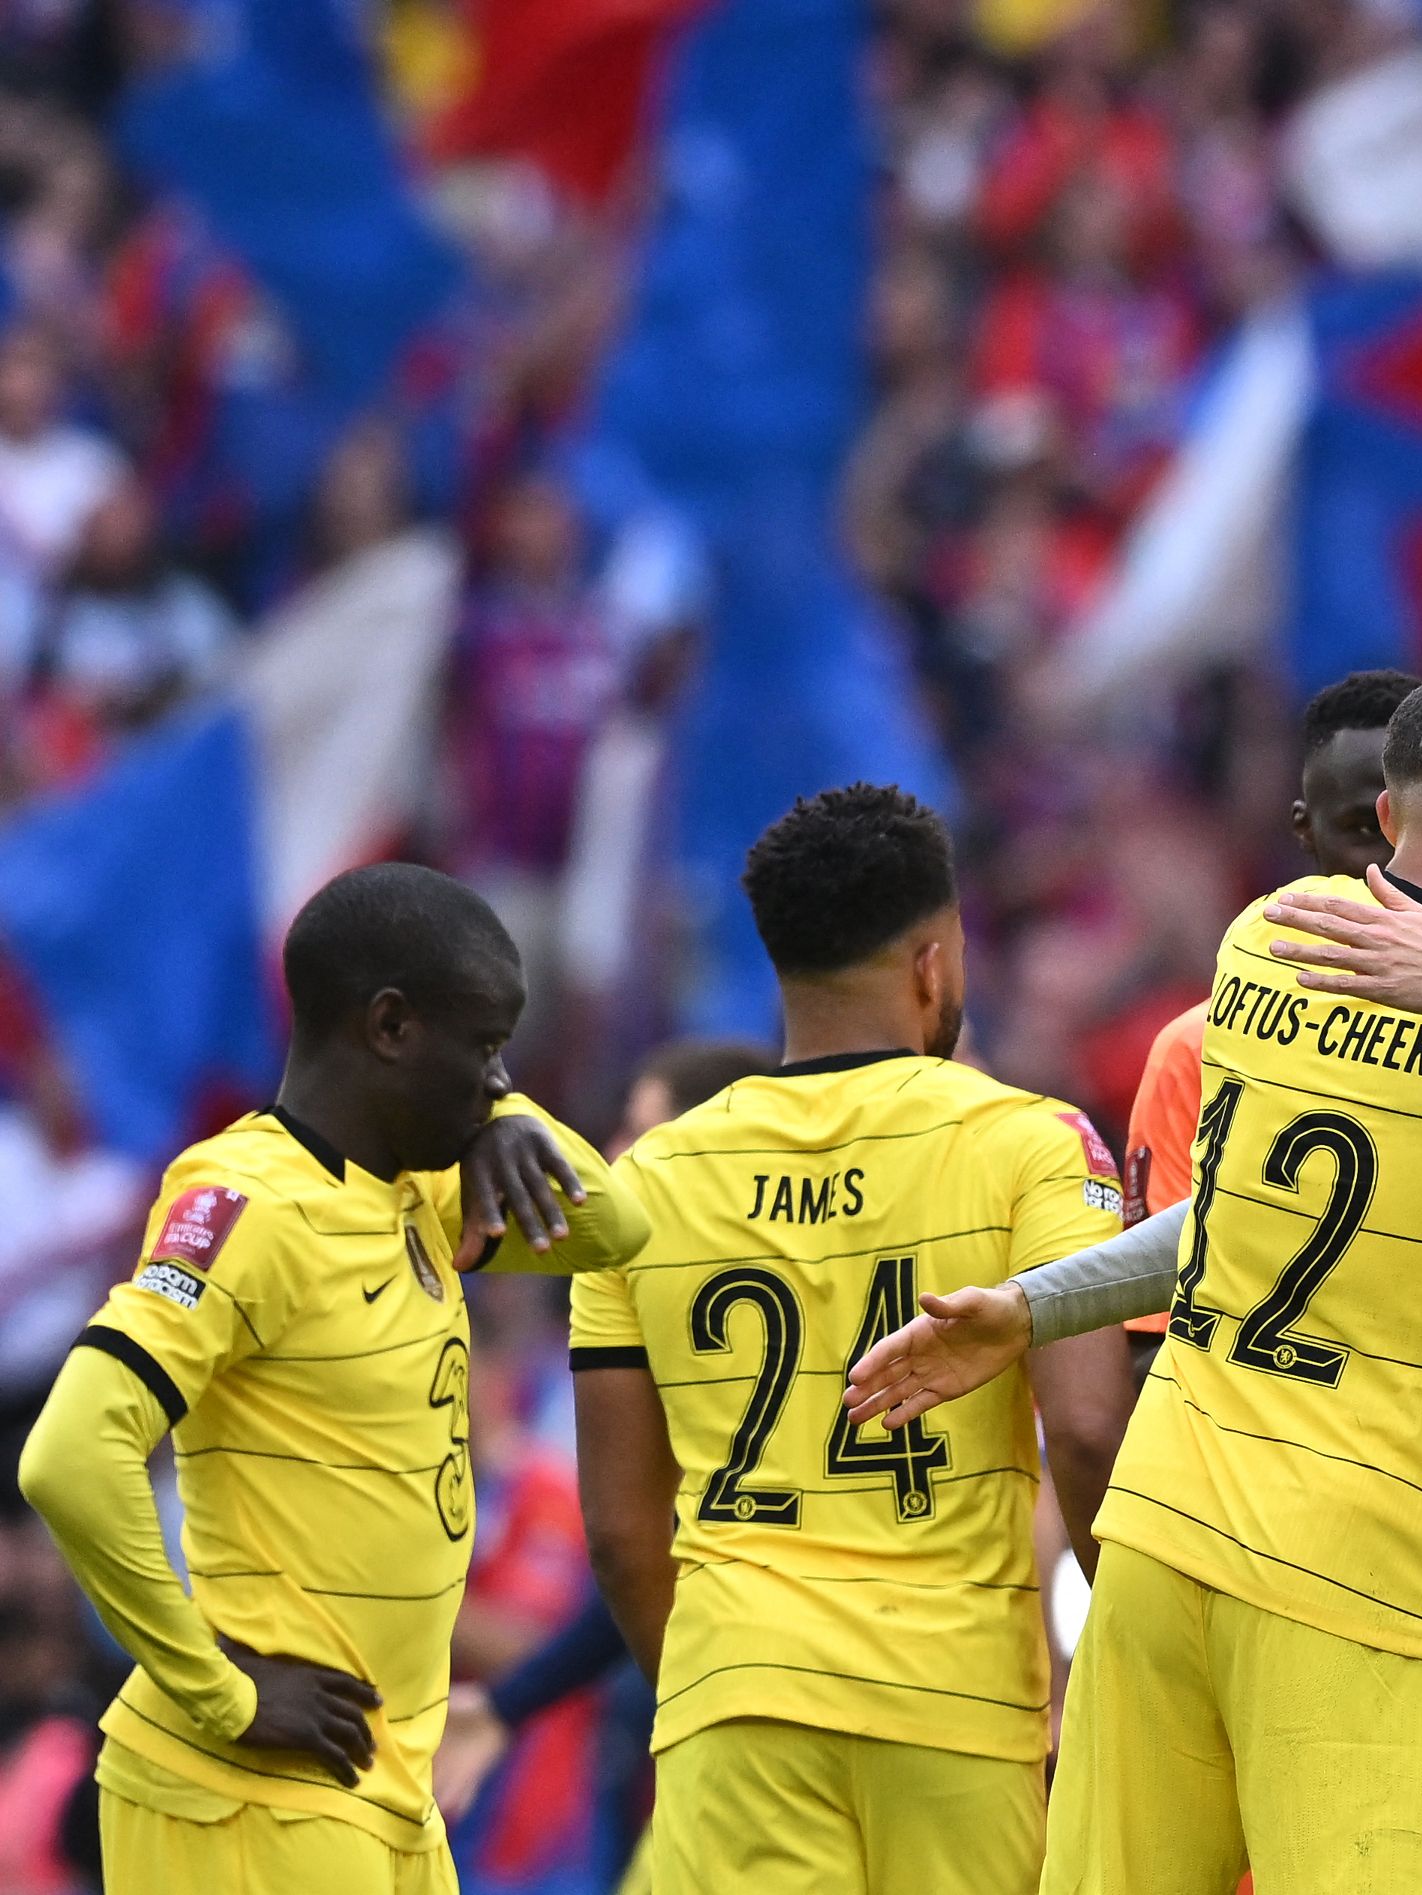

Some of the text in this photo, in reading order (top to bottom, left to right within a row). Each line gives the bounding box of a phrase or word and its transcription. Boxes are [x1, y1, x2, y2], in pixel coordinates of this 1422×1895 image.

[747, 1168, 865, 1225] JAMES
[1167, 1076, 1379, 1389] 12
[688, 1251, 953, 1530] 24
